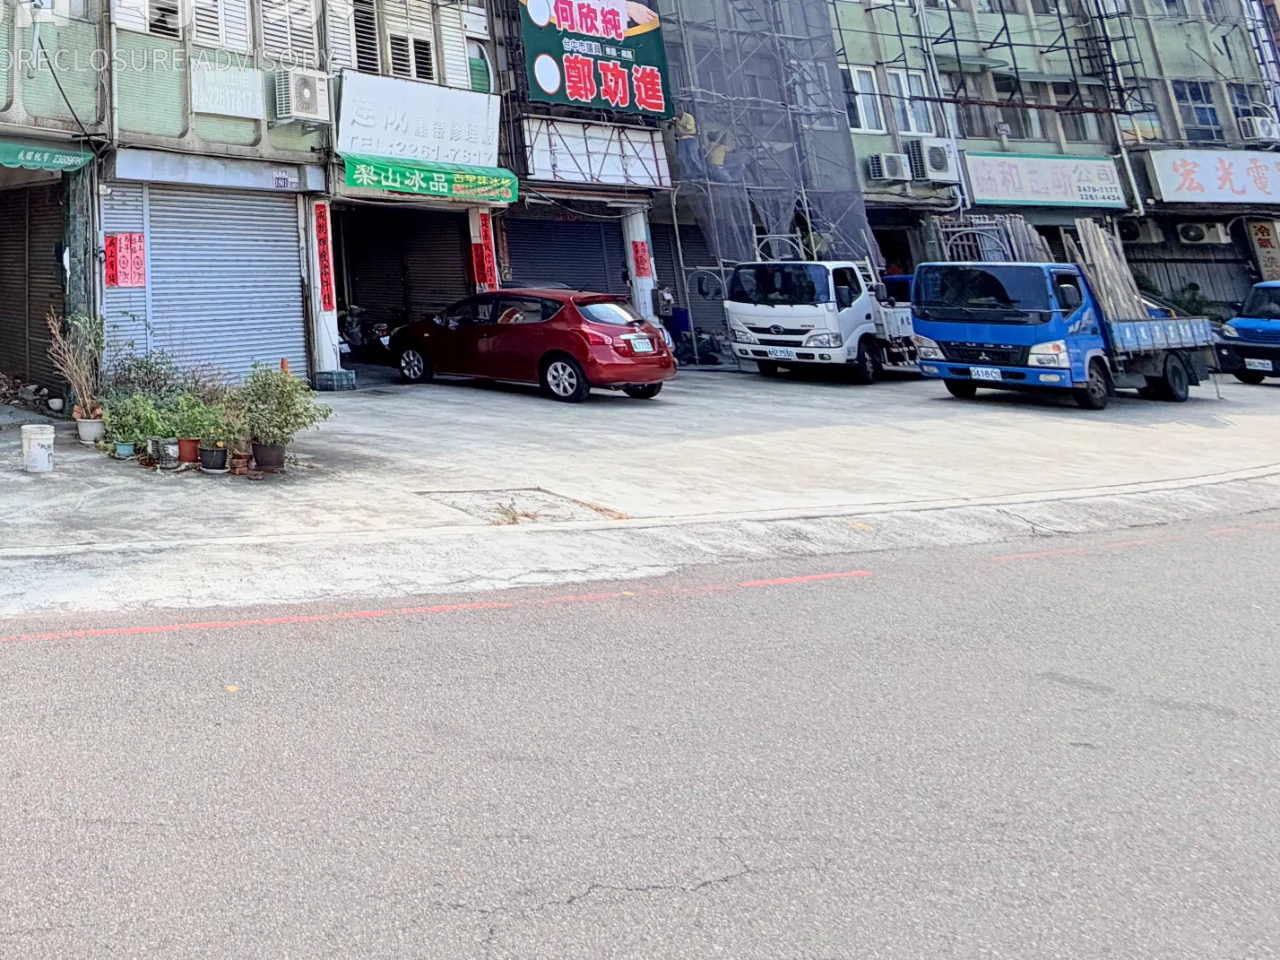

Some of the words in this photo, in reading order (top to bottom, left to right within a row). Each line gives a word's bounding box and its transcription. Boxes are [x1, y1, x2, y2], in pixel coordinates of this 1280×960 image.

[562, 37, 603, 56] 台中市議員
[563, 53, 665, 112] 鄭功進
[353, 164, 449, 193] 梨山冰品
[1172, 157, 1280, 195] 宏光電
